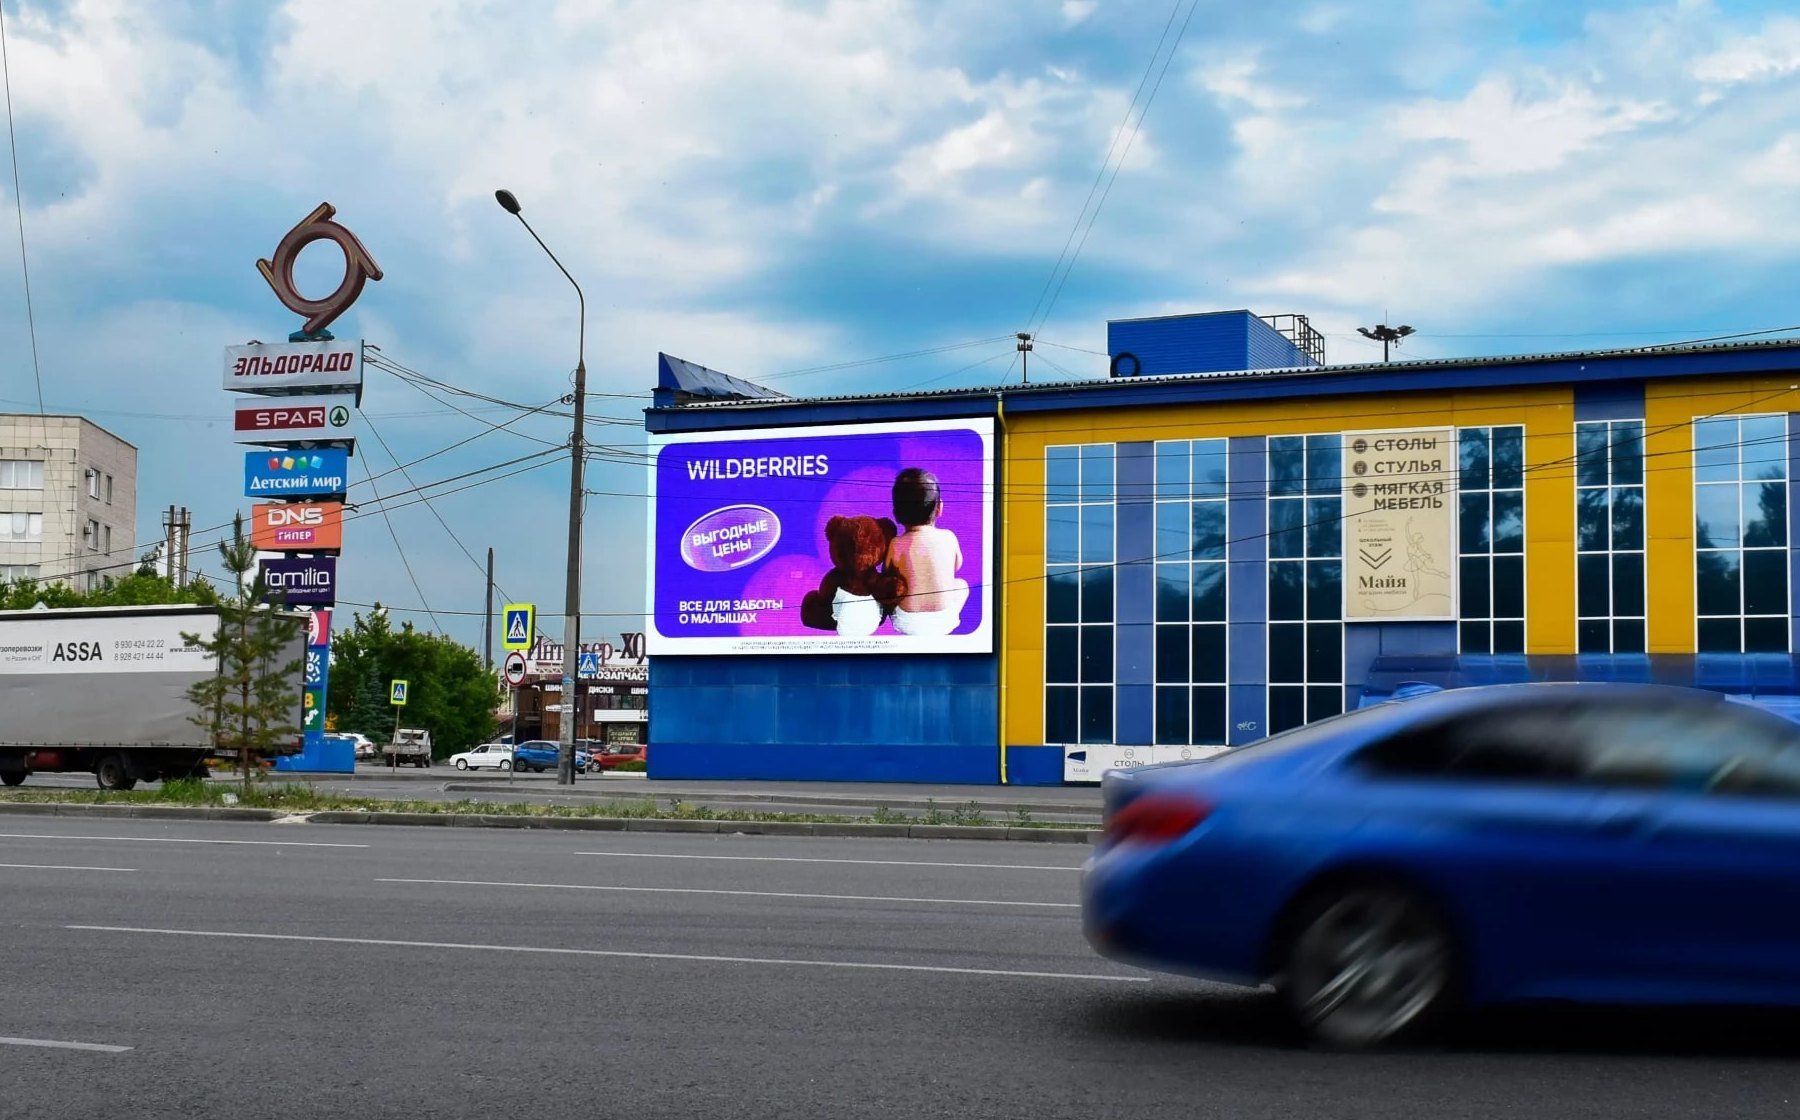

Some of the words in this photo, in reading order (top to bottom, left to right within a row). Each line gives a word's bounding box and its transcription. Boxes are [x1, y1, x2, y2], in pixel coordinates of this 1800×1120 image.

[233, 352, 353, 376] ЭЛЬДОРАДО
[256, 411, 323, 426] SPAR
[1374, 437, 1436, 452] СТОЛЫ
[687, 454, 829, 480] WILDBERRIES
[1374, 460, 1442, 474] СТУЛЬЯ
[251, 475, 308, 489] Детский
[312, 477, 341, 491] мир
[1374, 482, 1443, 496] МЯГКАЯ
[1374, 497, 1443, 510] МЕБЕЛЬ
[268, 508, 322, 525] DNS
[278, 531, 311, 541] ГИПЕР
[692, 519, 769, 547] ВЫГОДНЫЕ
[712, 538, 752, 558] ЦЕНЫ
[265, 567, 330, 586] familia
[1358, 575, 1406, 589] Майя
[679, 601, 702, 612] ВСЕ
[704, 601, 731, 613] ДЛЯ
[732, 599, 783, 611] ЗАБОТЫ
[679, 613, 688, 624] О
[691, 612, 757, 624] МАЛЫШАХ
[53, 641, 103, 662] ASSA
[588, 686, 614, 694] ДИСКИ
